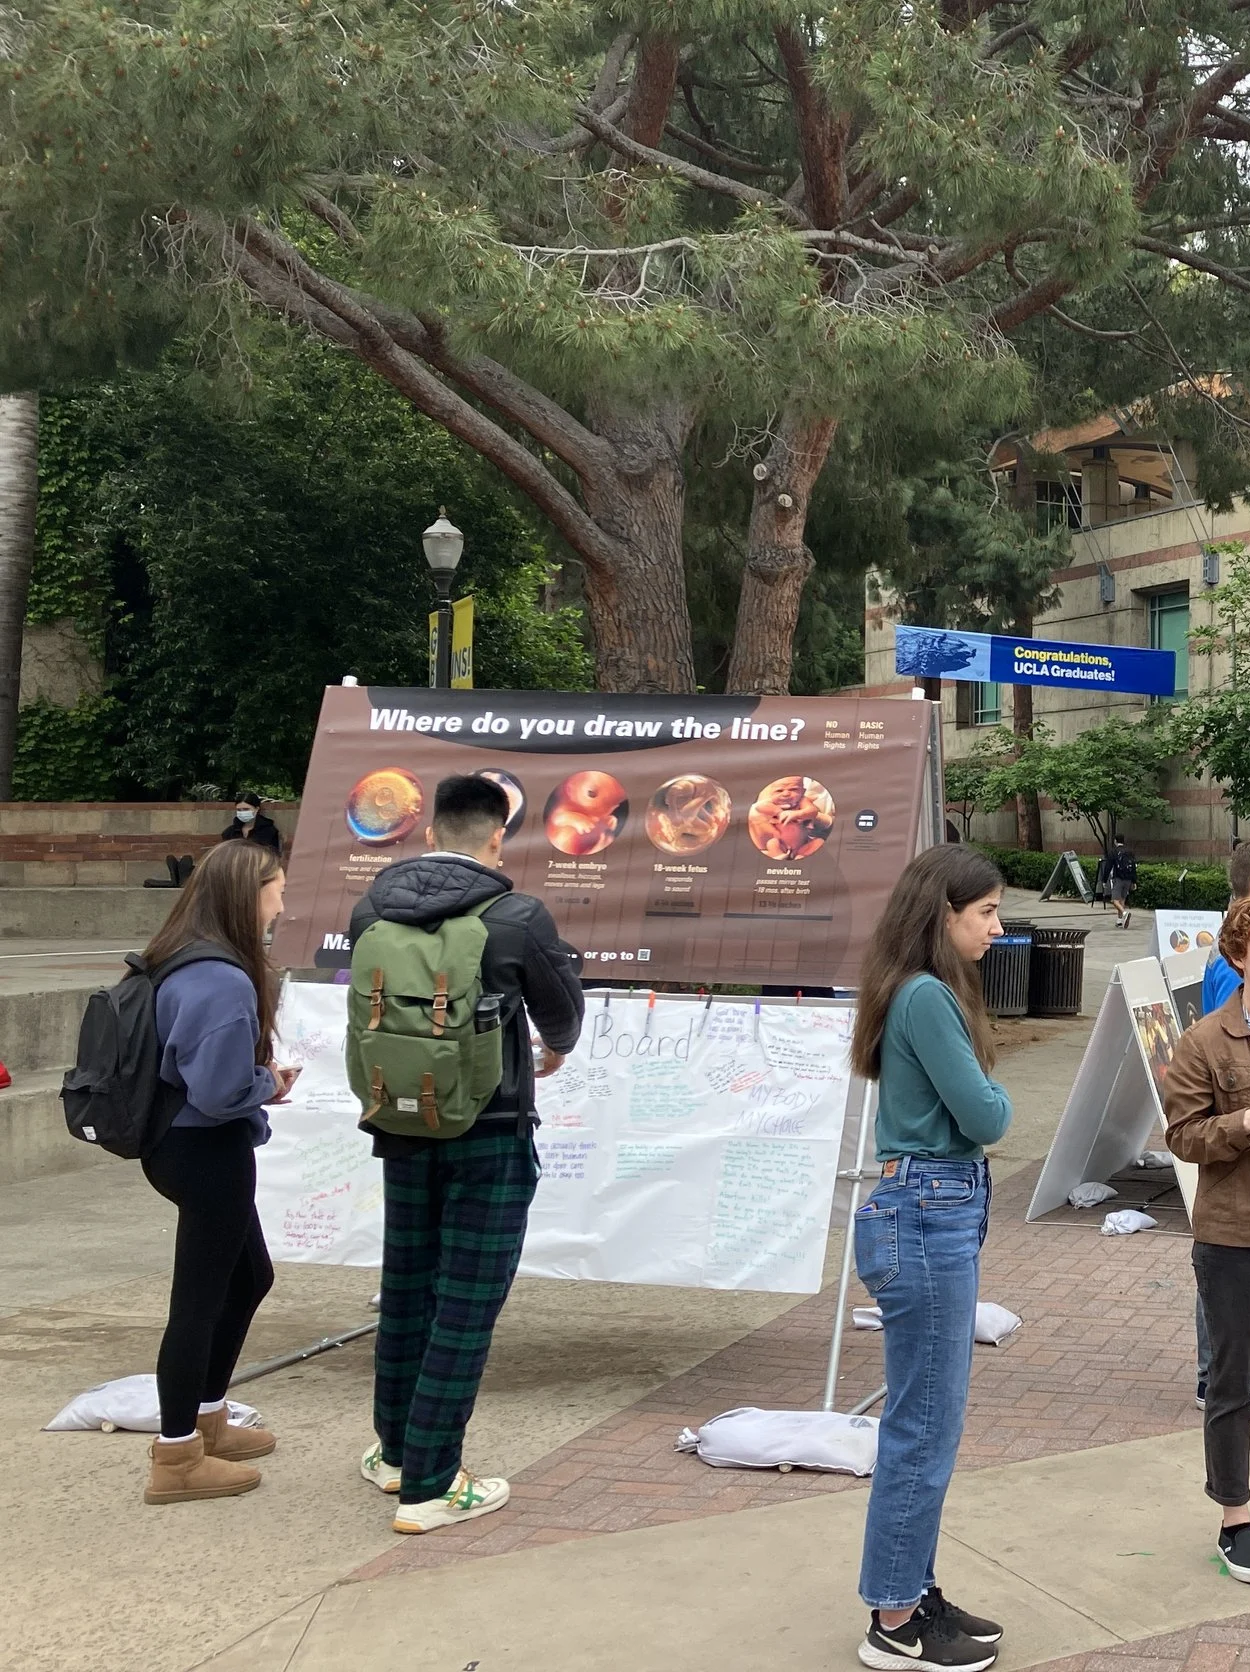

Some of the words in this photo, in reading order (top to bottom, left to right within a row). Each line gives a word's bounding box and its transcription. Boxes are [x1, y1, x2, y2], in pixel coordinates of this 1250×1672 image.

[1014, 646, 1112, 667] Congratulations,
[1014, 662, 1050, 677] UCLA
[1051, 665, 1115, 682] Graduates!
[369, 708, 462, 733] Where
[472, 711, 510, 734] do
[519, 718, 575, 740] you
[584, 715, 662, 737] draw
[671, 716, 721, 739] the
[731, 717, 805, 741] line?
[826, 721, 838, 729] NO
[860, 721, 884, 730] BASIC
[825, 731, 850, 739] Human
[859, 731, 884, 740] Human
[823, 741, 846, 750] Rights
[857, 742, 880, 750] Rights
[349, 853, 392, 863] fertilization
[548, 860, 577, 869] 7-week
[578, 862, 607, 872] embryo
[653, 863, 687, 872] 18-week
[688, 864, 708, 873] fetus
[766, 867, 802, 876] newborn
[584, 951, 598, 960] or
[600, 951, 617, 962] go
[620, 951, 634, 961] to
[590, 1013, 694, 1061] Board
[749, 1084, 773, 1108] MY
[773, 1087, 821, 1115] BODY
[735, 1110, 768, 1135] MY
[763, 1115, 805, 1136] CHOICE
